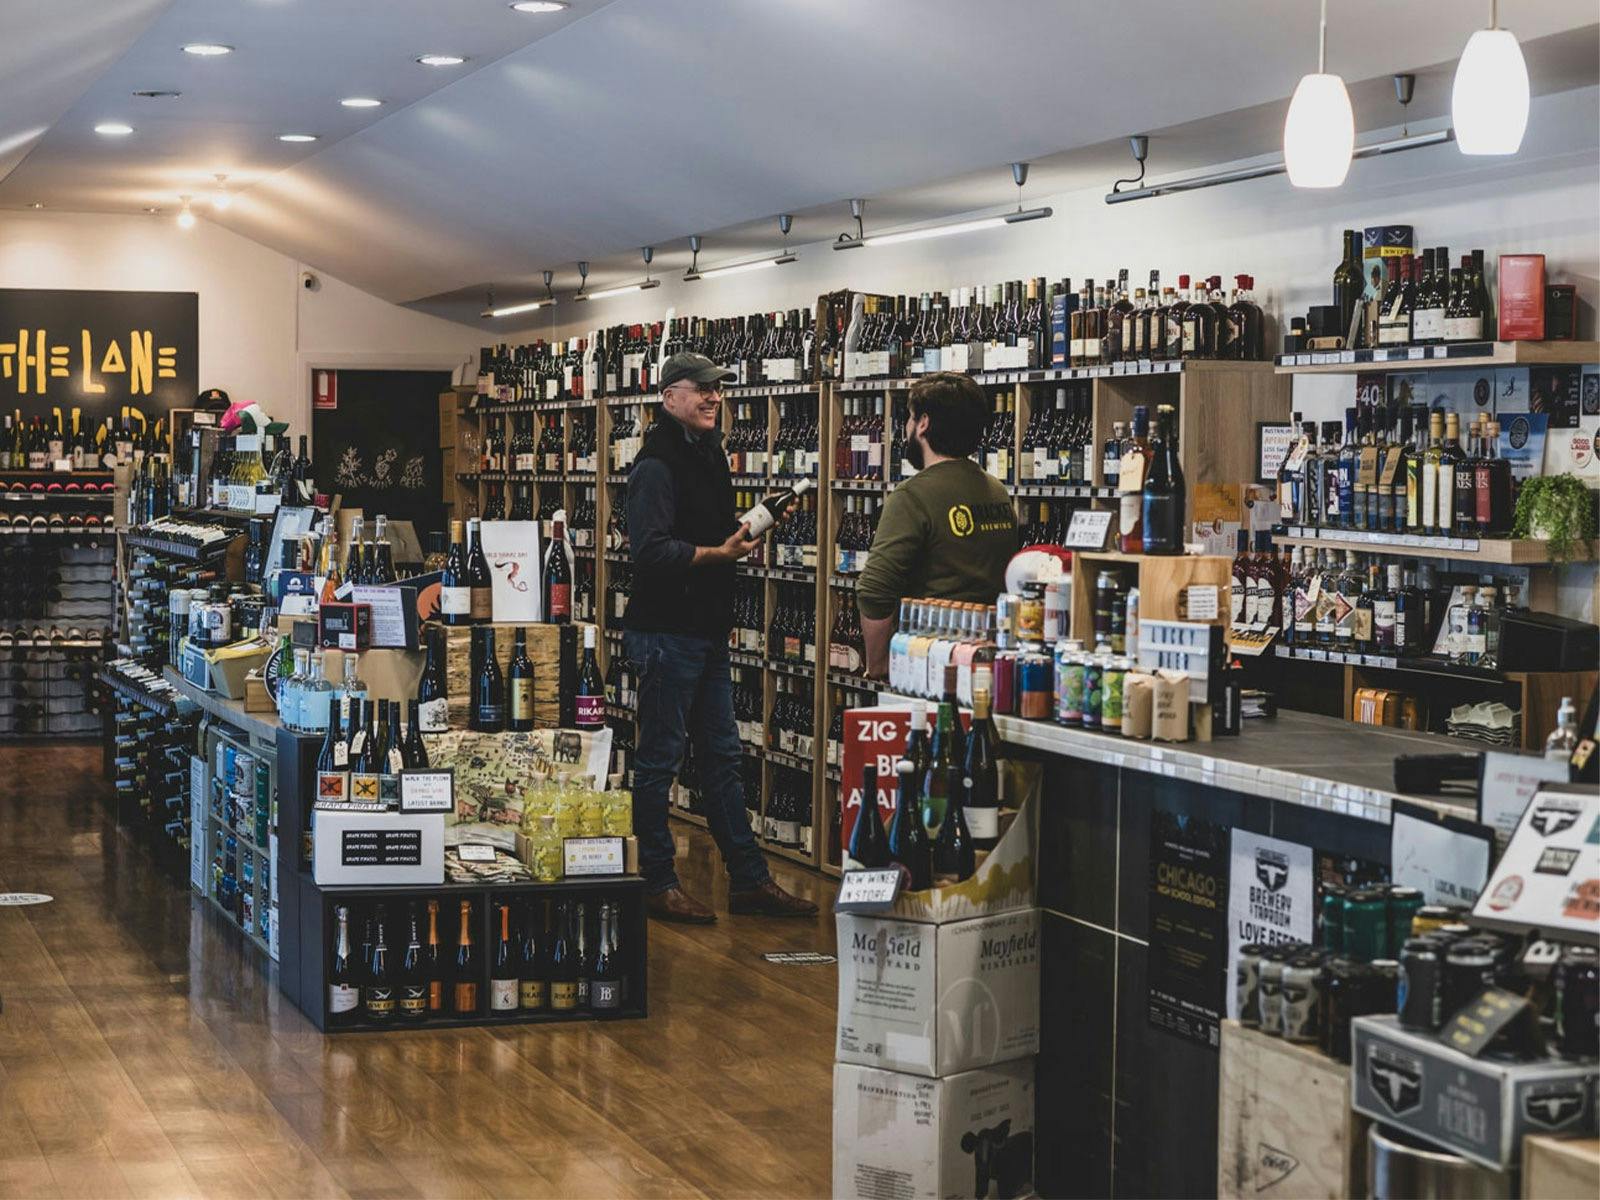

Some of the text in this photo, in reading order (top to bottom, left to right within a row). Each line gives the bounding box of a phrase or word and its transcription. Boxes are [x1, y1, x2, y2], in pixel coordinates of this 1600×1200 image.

[0, 329, 177, 395] THE LANE
[1361, 384, 1380, 406] 40
[980, 522, 1012, 532] BREWING
[1152, 626, 1195, 645] LUCKY
[1158, 651, 1189, 670] BEER
[857, 720, 897, 742] ZIG
[1158, 862, 1216, 896] CHICAGO
[1250, 886, 1292, 912] BREWERY
[1254, 904, 1291, 928] TAPROOM
[1240, 920, 1266, 945] LOVE
[852, 933, 921, 958] Mafield
[980, 930, 1036, 959] Mayfield
[852, 954, 920, 972] VINYARD
[980, 954, 1036, 972] VINEYARD
